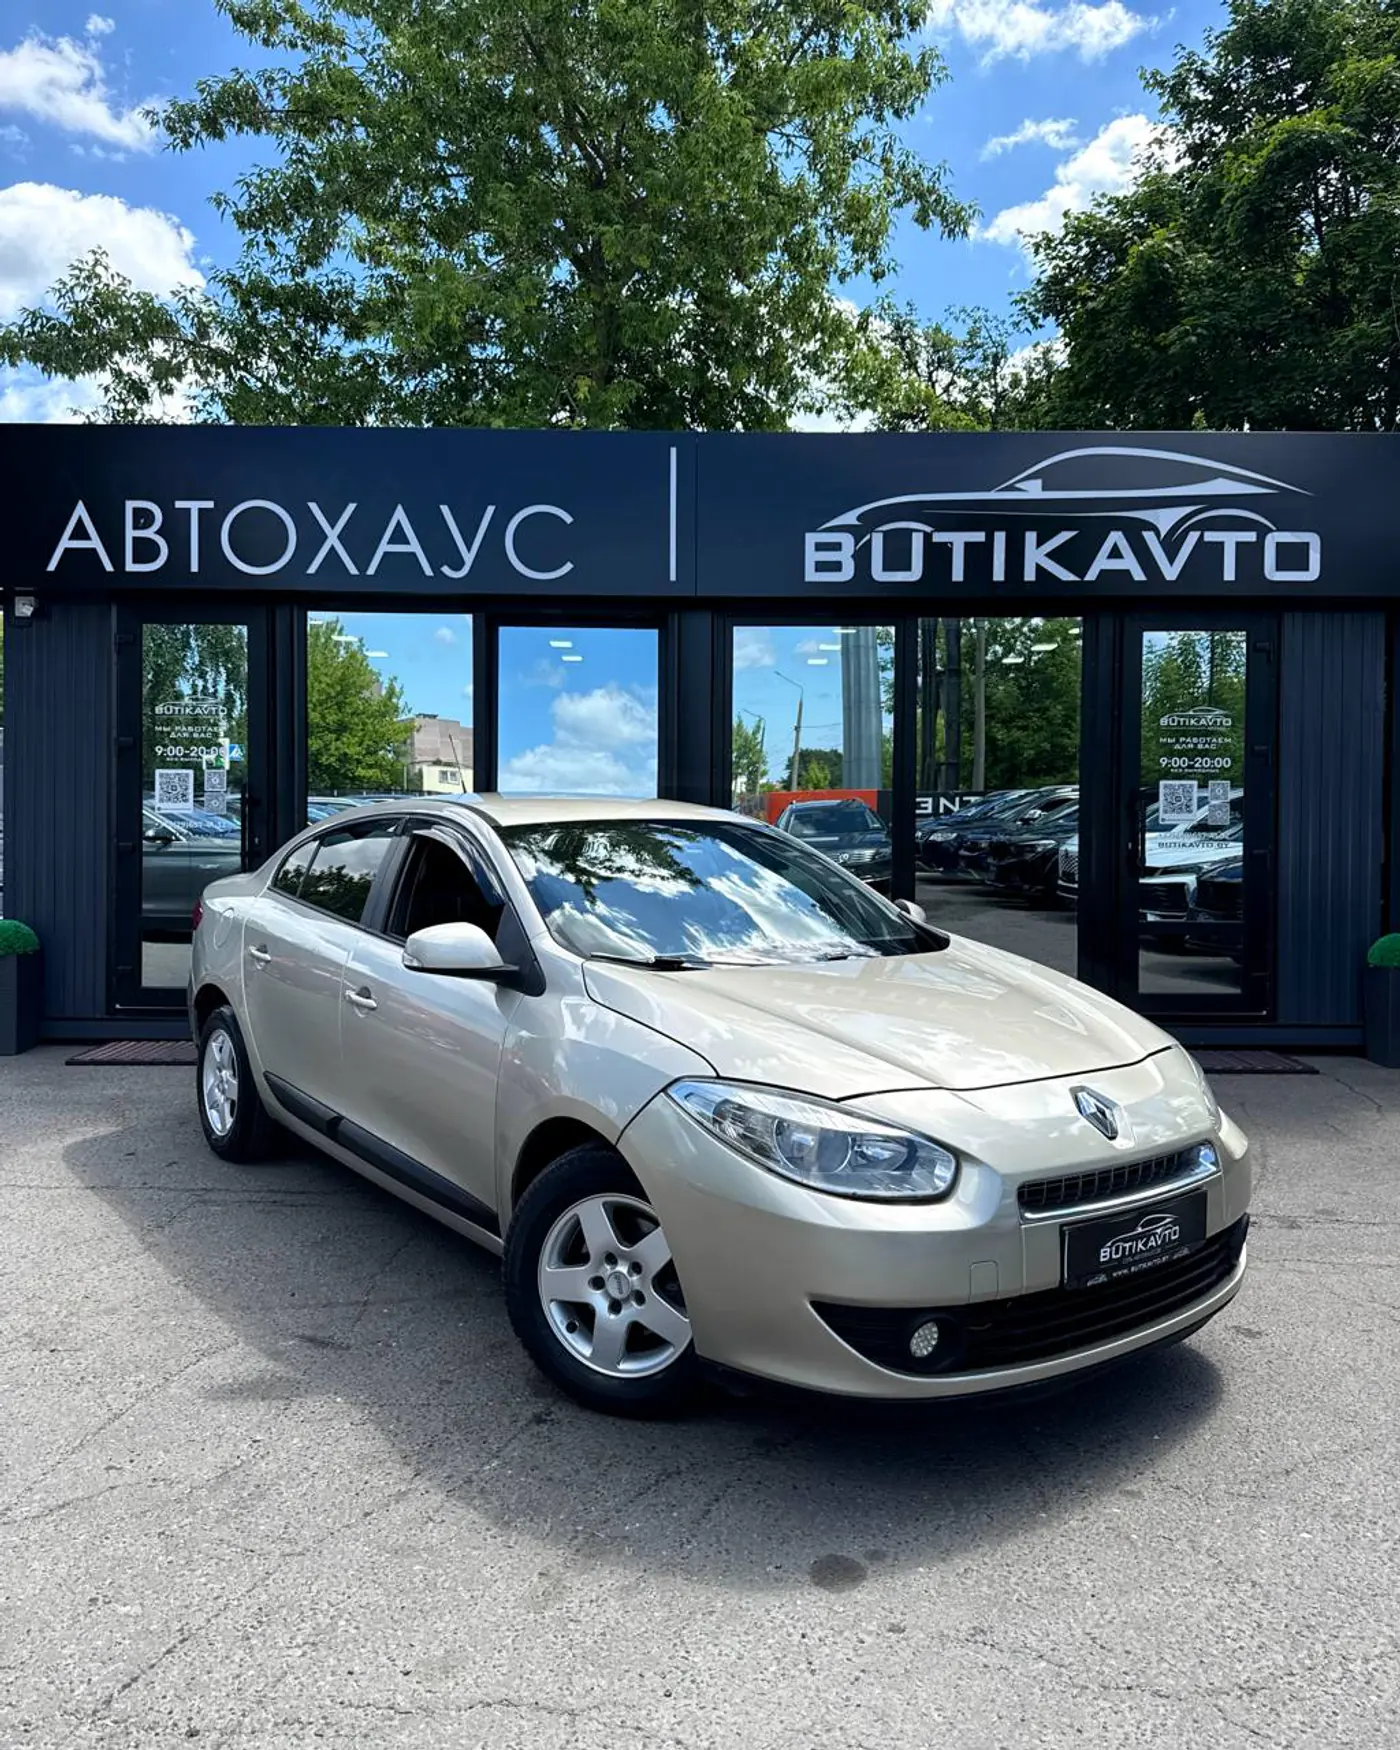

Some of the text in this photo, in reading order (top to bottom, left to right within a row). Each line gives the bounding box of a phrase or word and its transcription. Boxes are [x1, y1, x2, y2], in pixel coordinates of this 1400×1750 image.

[47, 499, 574, 580] АВТОХАУС
[803, 529, 1321, 583] BUTIKAVTO
[154, 705, 227, 715] BUTIKAVTO
[1160, 717, 1232, 726] BUTIKAVTO
[1160, 757, 1232, 768] 9:00-20:00
[1100, 1225, 1180, 1262] BUTIKAVTO
